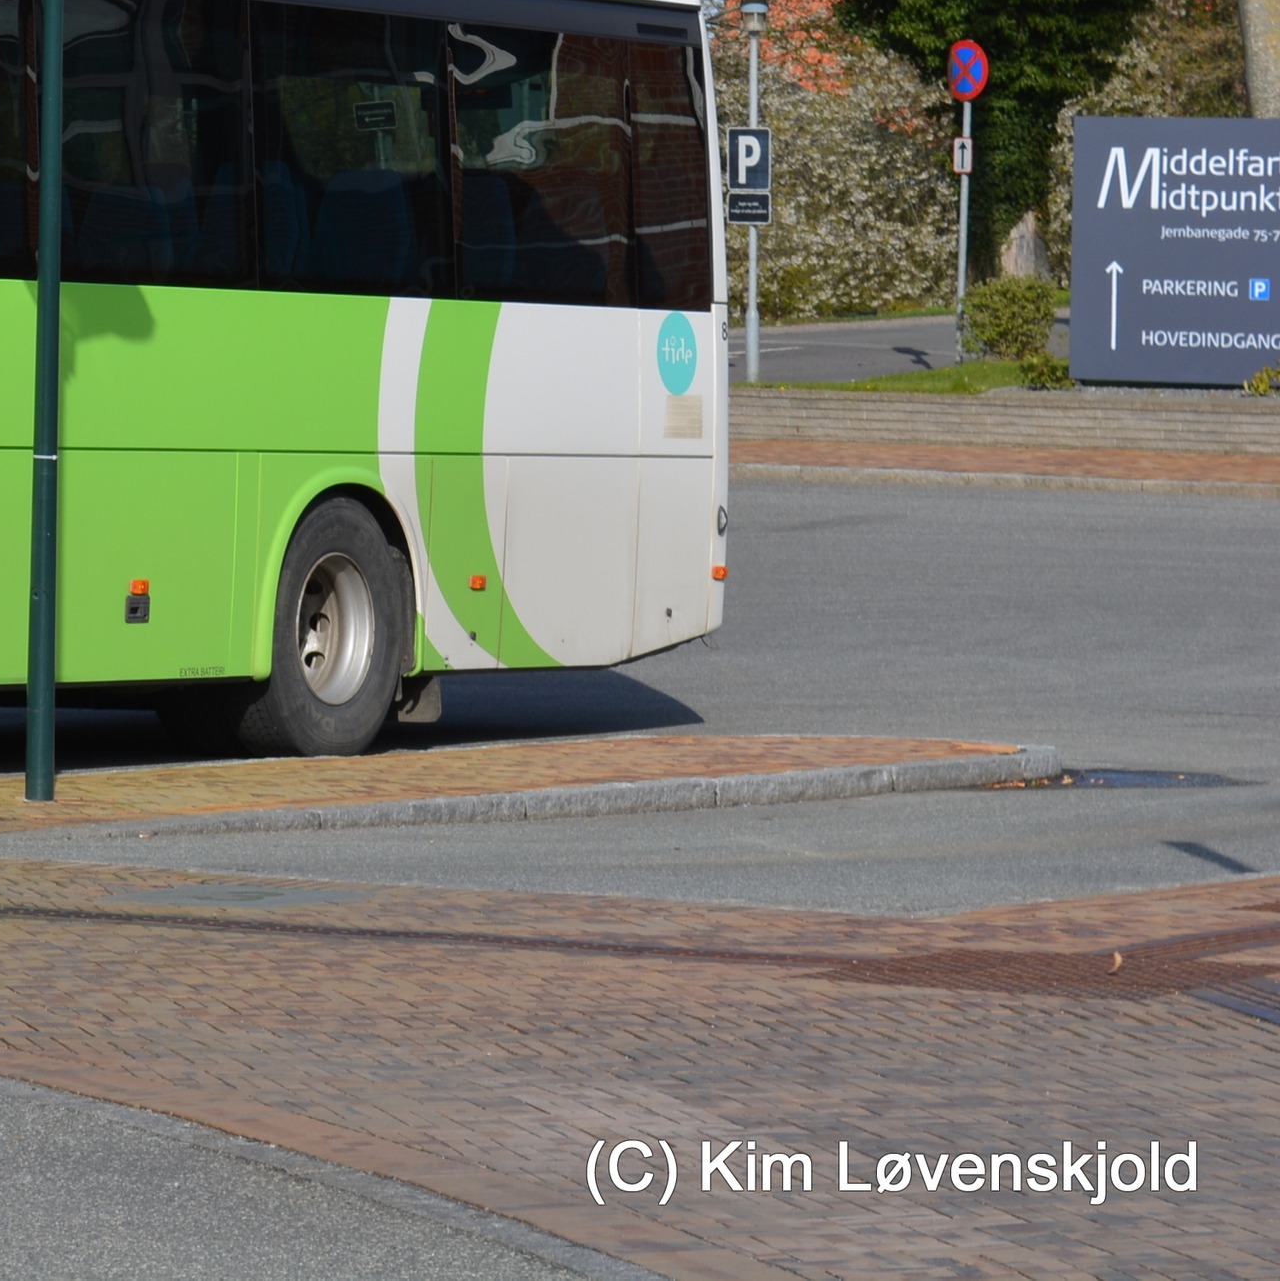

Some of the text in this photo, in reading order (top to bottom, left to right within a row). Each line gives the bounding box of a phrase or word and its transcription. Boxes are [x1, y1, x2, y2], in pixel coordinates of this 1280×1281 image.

[738, 135, 761, 185] P
[1097, 147, 1280, 209] Middelfar
[1160, 225, 1250, 241] Jernbanegade
[1142, 279, 1239, 297] PARKERING
[1141, 330, 1280, 350] HOVEDINDGANG
[180, 666, 225, 677] EXTRA BATTERI
